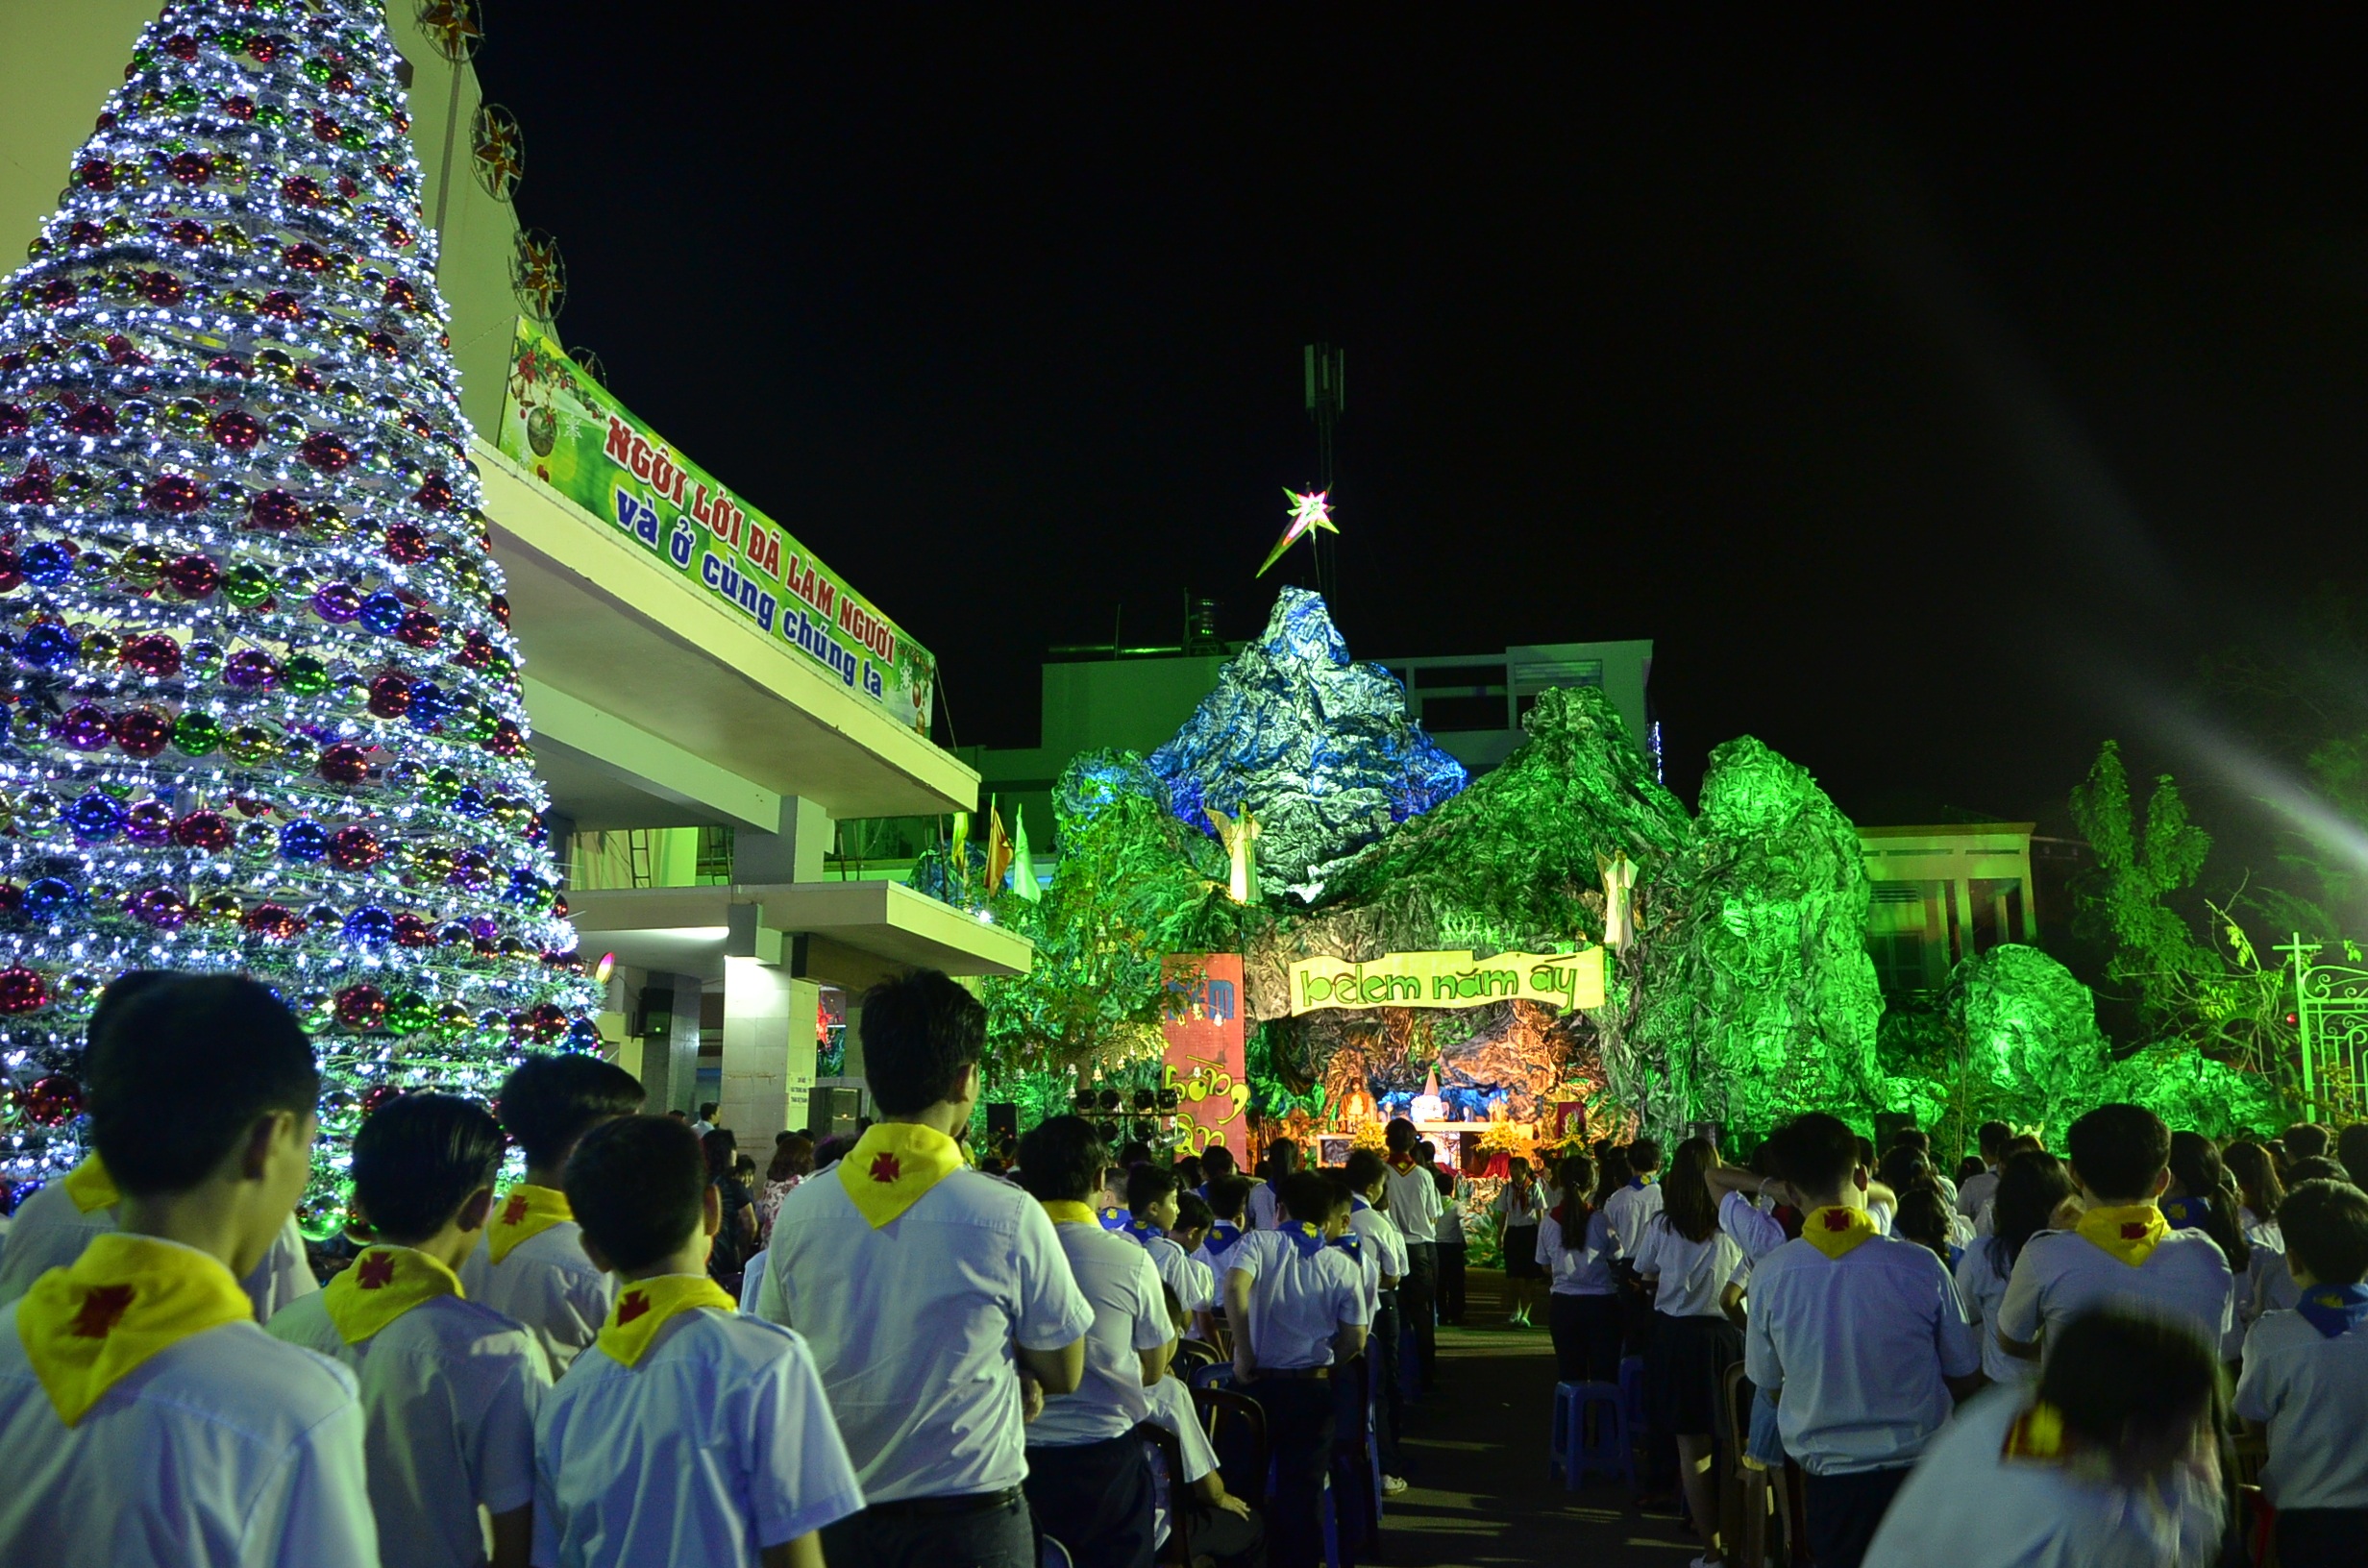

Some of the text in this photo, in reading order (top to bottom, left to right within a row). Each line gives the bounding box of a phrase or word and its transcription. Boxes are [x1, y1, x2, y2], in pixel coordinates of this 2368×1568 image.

[604, 414, 895, 665] NGÔI LỜI ĐÃ LÀM NGƯỜI
[616, 487, 882, 698] và ở cùng chúng ta
